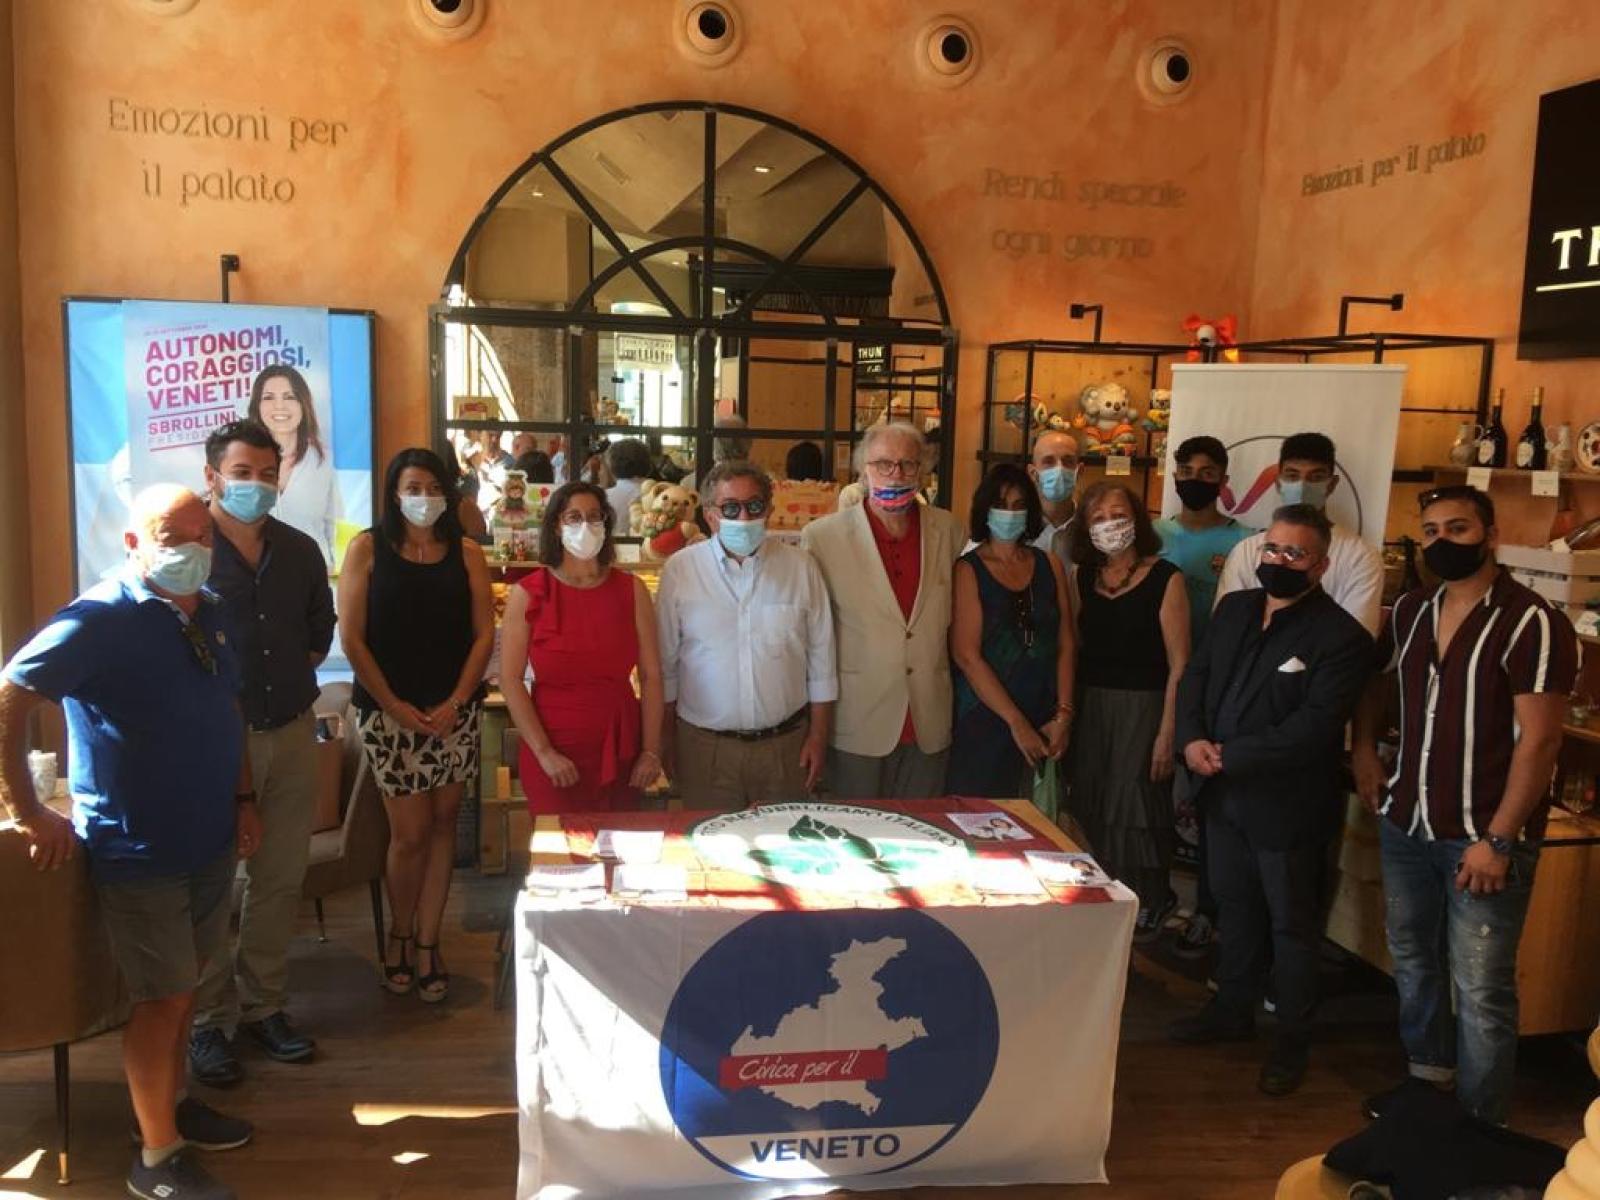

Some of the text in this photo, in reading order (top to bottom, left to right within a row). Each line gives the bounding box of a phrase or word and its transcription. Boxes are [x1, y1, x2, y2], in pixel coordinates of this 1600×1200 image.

[108, 97, 349, 151] Emozioni per
[1302, 132, 1486, 196] Emozioni per il palato
[141, 159, 296, 206] il palato
[984, 168, 1062, 200] Rendi
[146, 325, 288, 363] AUTONOMI,
[858, 346, 882, 358] THUN
[146, 346, 311, 387] CORAGGIOSI,
[147, 377, 250, 410] VENETI!
[149, 411, 238, 435] SBROLLINI
[738, 1050, 860, 1083] Civica per il
[750, 1133, 900, 1163] VENETO
